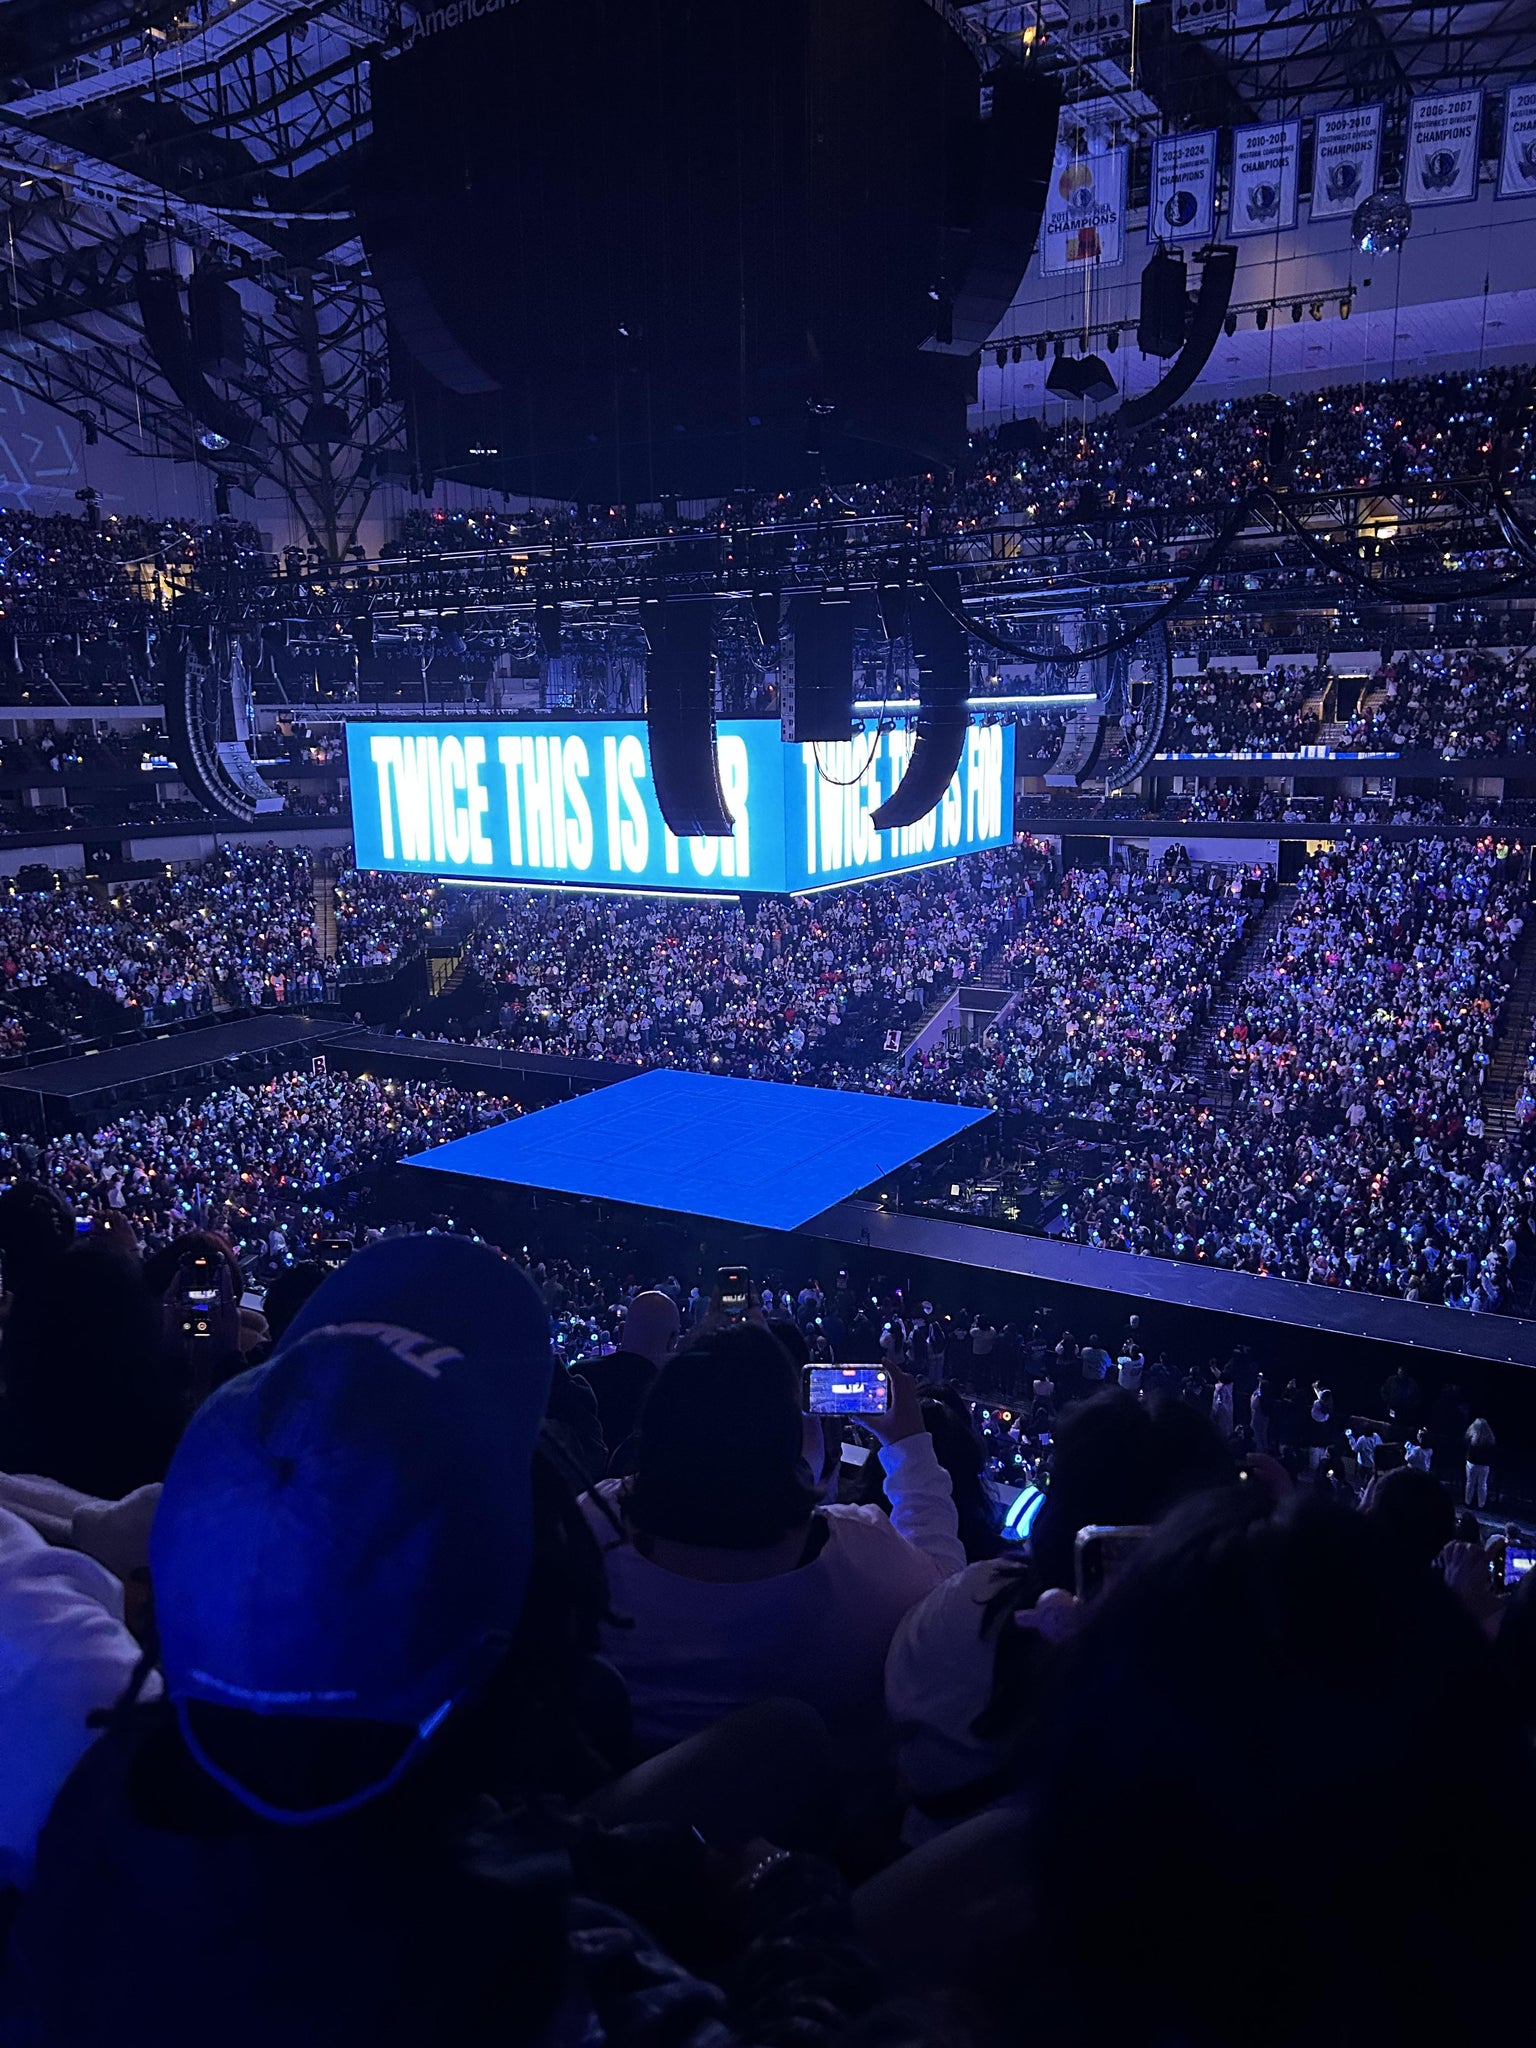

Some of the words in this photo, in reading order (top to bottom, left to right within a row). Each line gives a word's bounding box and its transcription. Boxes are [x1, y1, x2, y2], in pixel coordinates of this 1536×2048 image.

[1419, 100, 1473, 118] 2006-2007
[1325, 115, 1372, 133] 2009-2010
[1416, 126, 1473, 144] CHAMPIONS
[1162, 144, 1205, 162] 2023-2024
[1320, 140, 1374, 158] CHAMPIONS
[1241, 156, 1290, 174] CHAMPIONS
[1160, 169, 1205, 186] CHAMPIONS
[1047, 212, 1117, 234] CHAMPIONS
[370, 735, 493, 864] TWICE
[498, 735, 593, 871] THIS
[603, 735, 649, 874] IS
[802, 730, 882, 875] TWICE
[966, 724, 1003, 843] FOR
